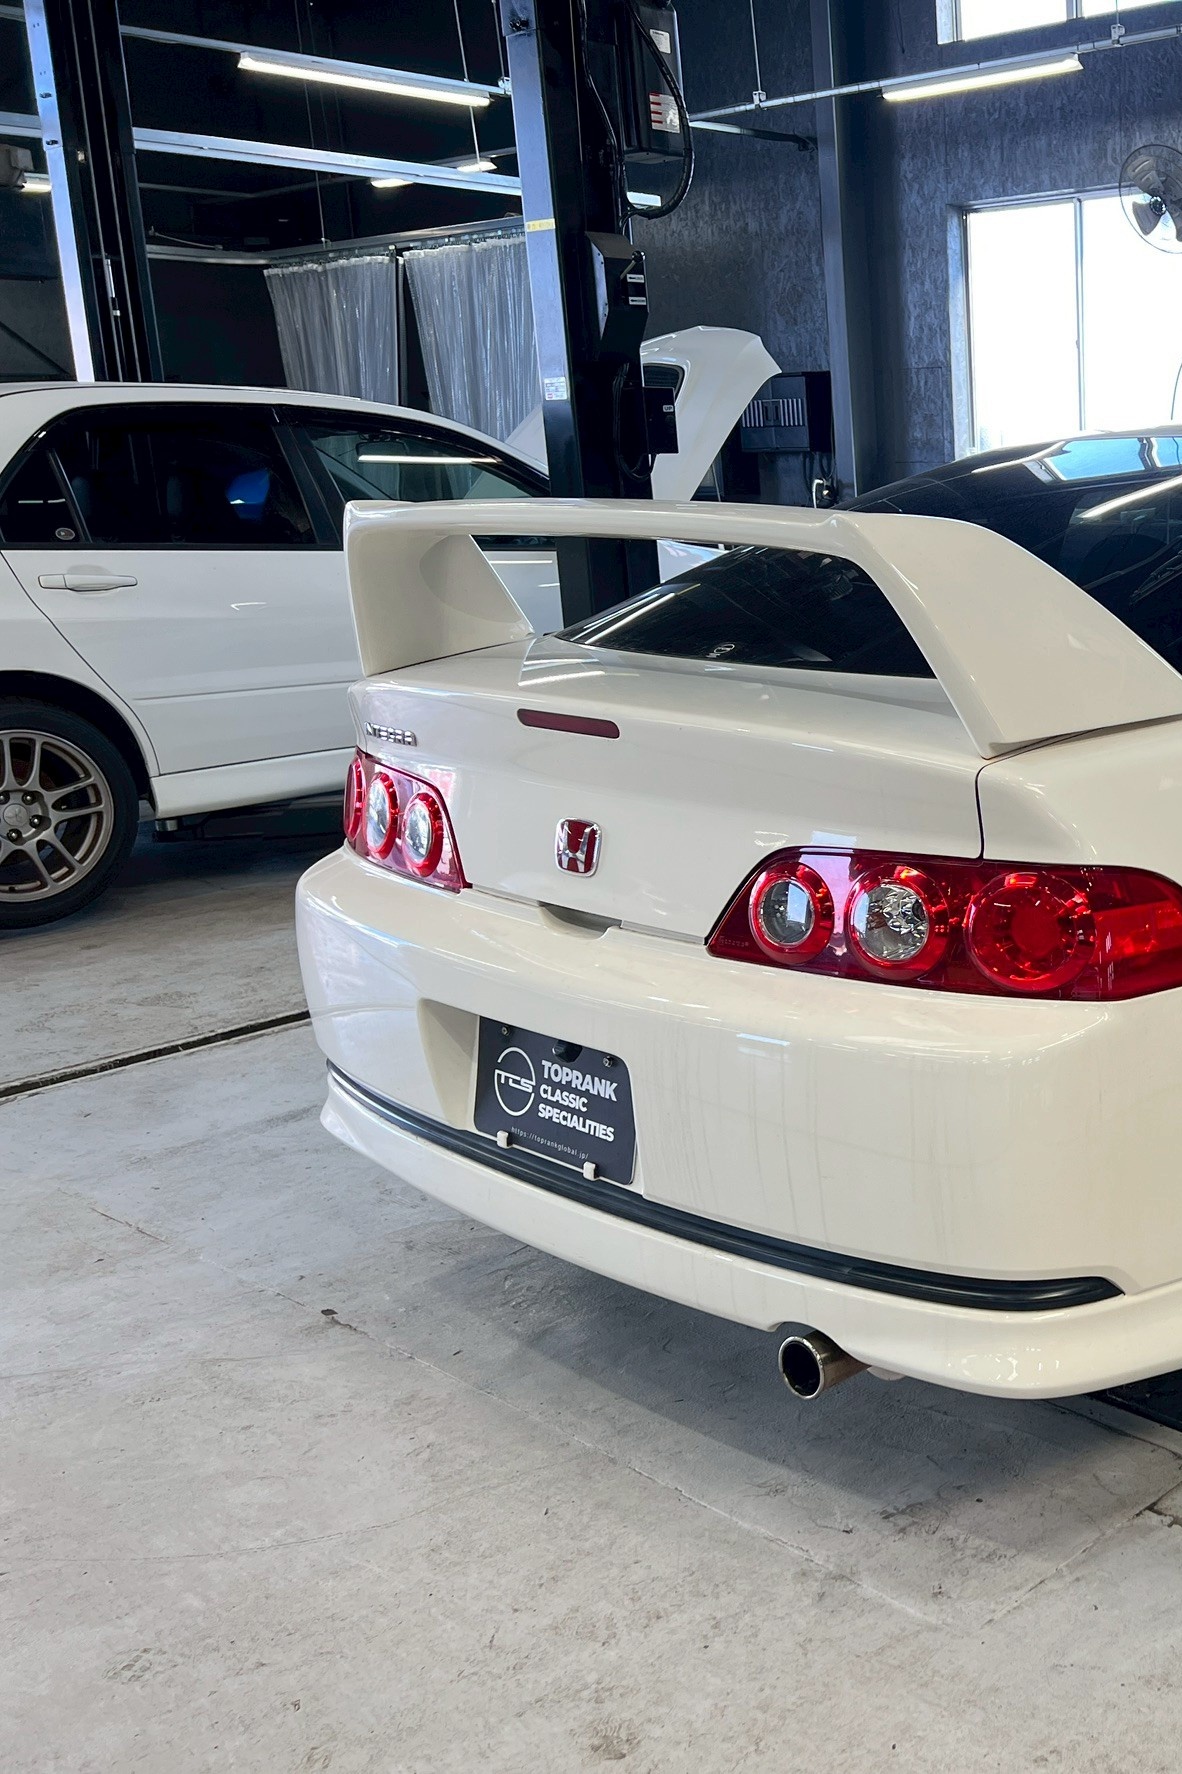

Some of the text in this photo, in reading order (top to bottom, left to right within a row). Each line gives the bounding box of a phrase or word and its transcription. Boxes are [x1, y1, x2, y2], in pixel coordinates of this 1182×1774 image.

[364, 721, 418, 747] NTEGRA
[541, 1059, 618, 1102] TOPRANK
[539, 1084, 588, 1112] CLASSIC
[538, 1103, 615, 1142] SPECIALITIES
[511, 1126, 589, 1160] https://toprankglobal.jp/
